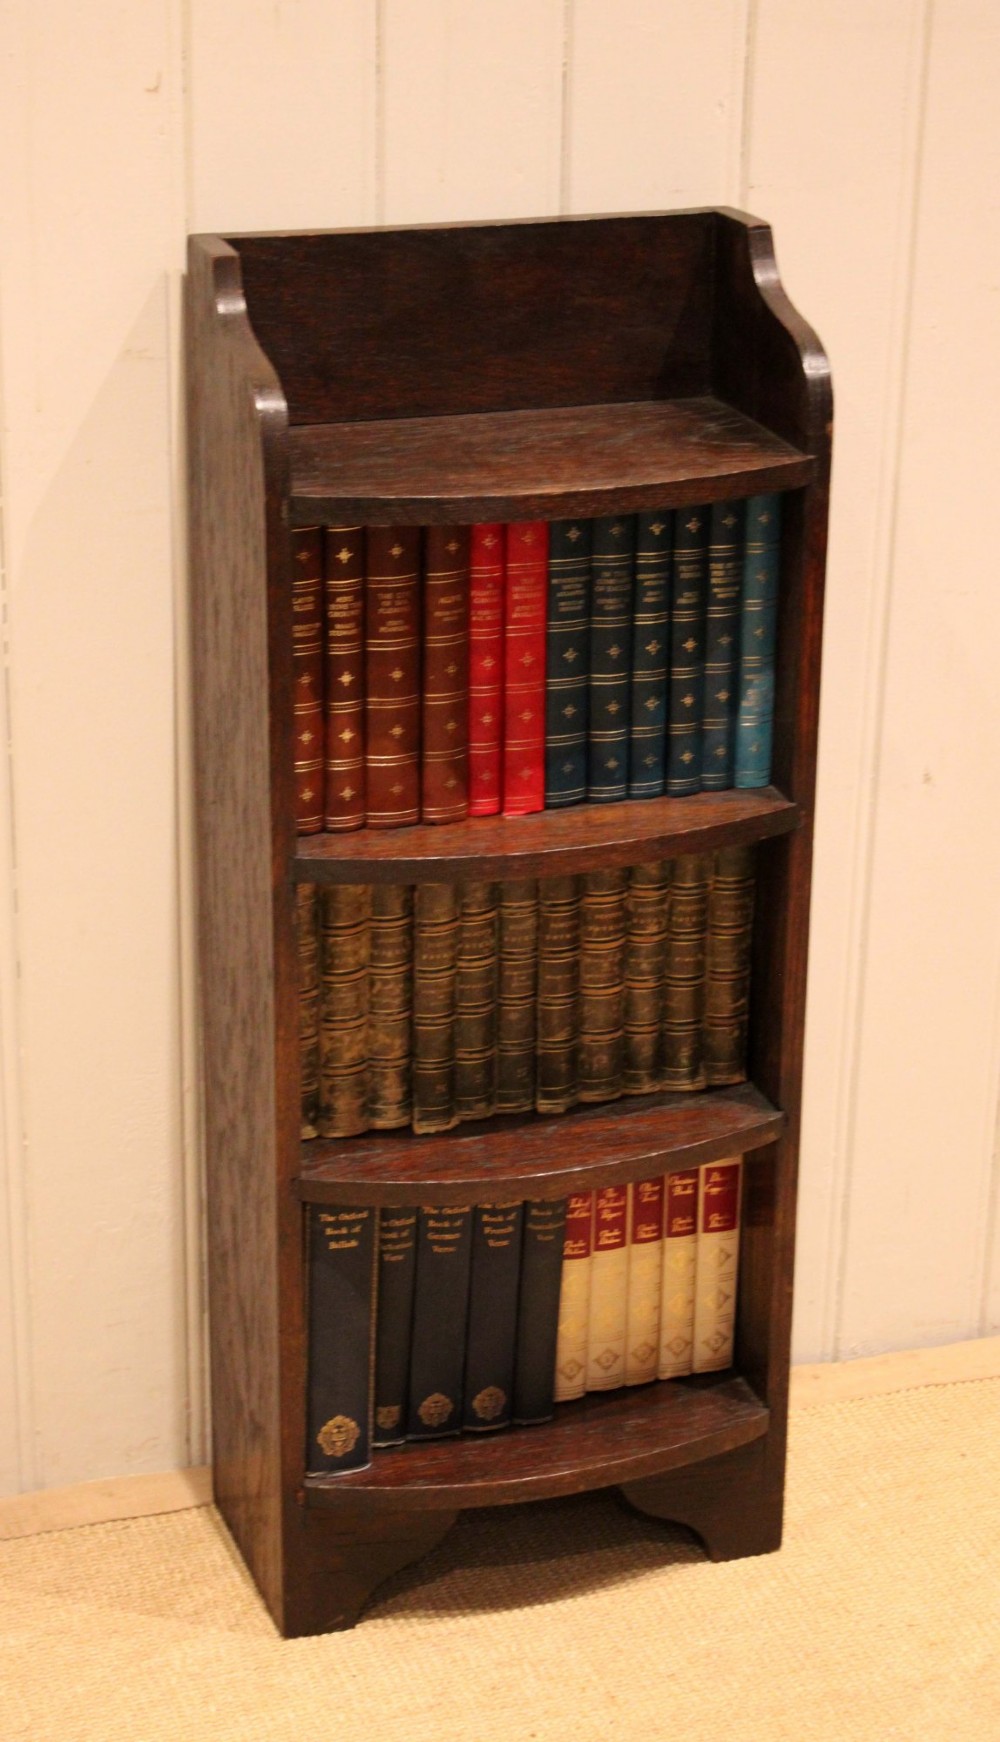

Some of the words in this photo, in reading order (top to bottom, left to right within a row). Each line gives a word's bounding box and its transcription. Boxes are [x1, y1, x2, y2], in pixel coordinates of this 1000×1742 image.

[338, 1210, 369, 1221] Oxford
[482, 1214, 504, 1222] Book
[428, 1219, 450, 1228] Book
[325, 1227, 348, 1236] Book
[382, 1231, 399, 1239] ook
